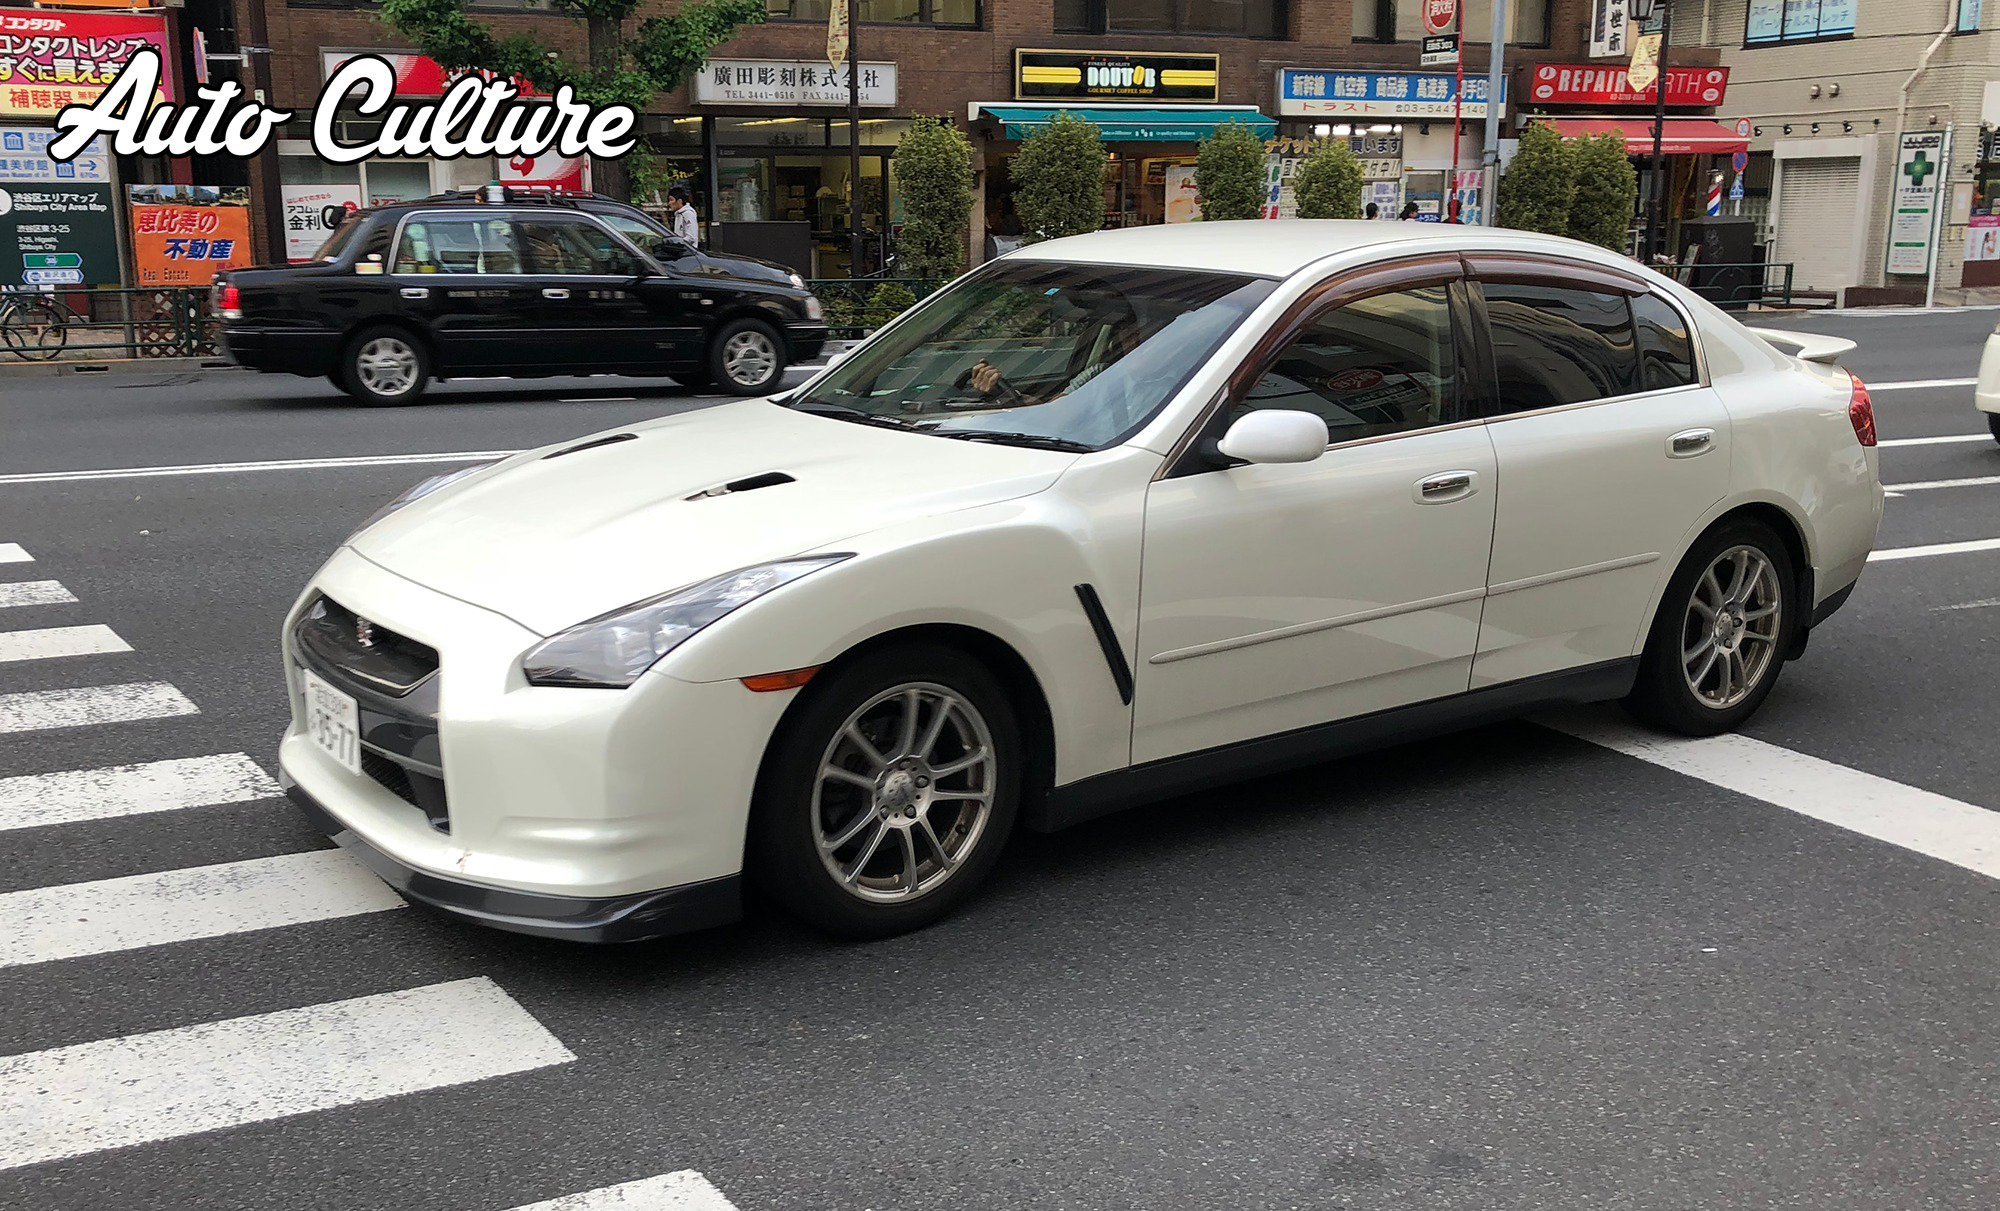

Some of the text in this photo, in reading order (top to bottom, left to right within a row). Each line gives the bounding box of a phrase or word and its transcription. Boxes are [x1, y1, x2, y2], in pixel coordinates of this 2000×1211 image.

[5, 17, 66, 31] コンタクト
[1087, 66, 1156, 87] DOUTOR
[1558, 69, 1702, 94] REPAIR ARTH
[1293, 75, 1325, 96] 新幹線
[1334, 76, 1367, 98] 航空券
[1376, 76, 1408, 98] 商品券
[1416, 77, 1448, 99] 高速券
[9, 89, 74, 109] 補聴器
[725, 90, 870, 101] TEL 3441-0516 FAX 3441-54
[1303, 102, 1376, 112] トラスト
[1350, 137, 1401, 154] 買います
[13, 193, 98, 203] 渋谷区エリアマップ
[14, 203, 49, 212] Shibuya
[50, 203, 68, 212] City
[89, 204, 107, 212] Map
[50, 225, 70, 233] 3-25
[138, 209, 219, 234] 恵比寿の
[288, 215, 320, 231] 金利
[163, 238, 236, 260] 不動産
[163, 268, 189, 281] Estate
